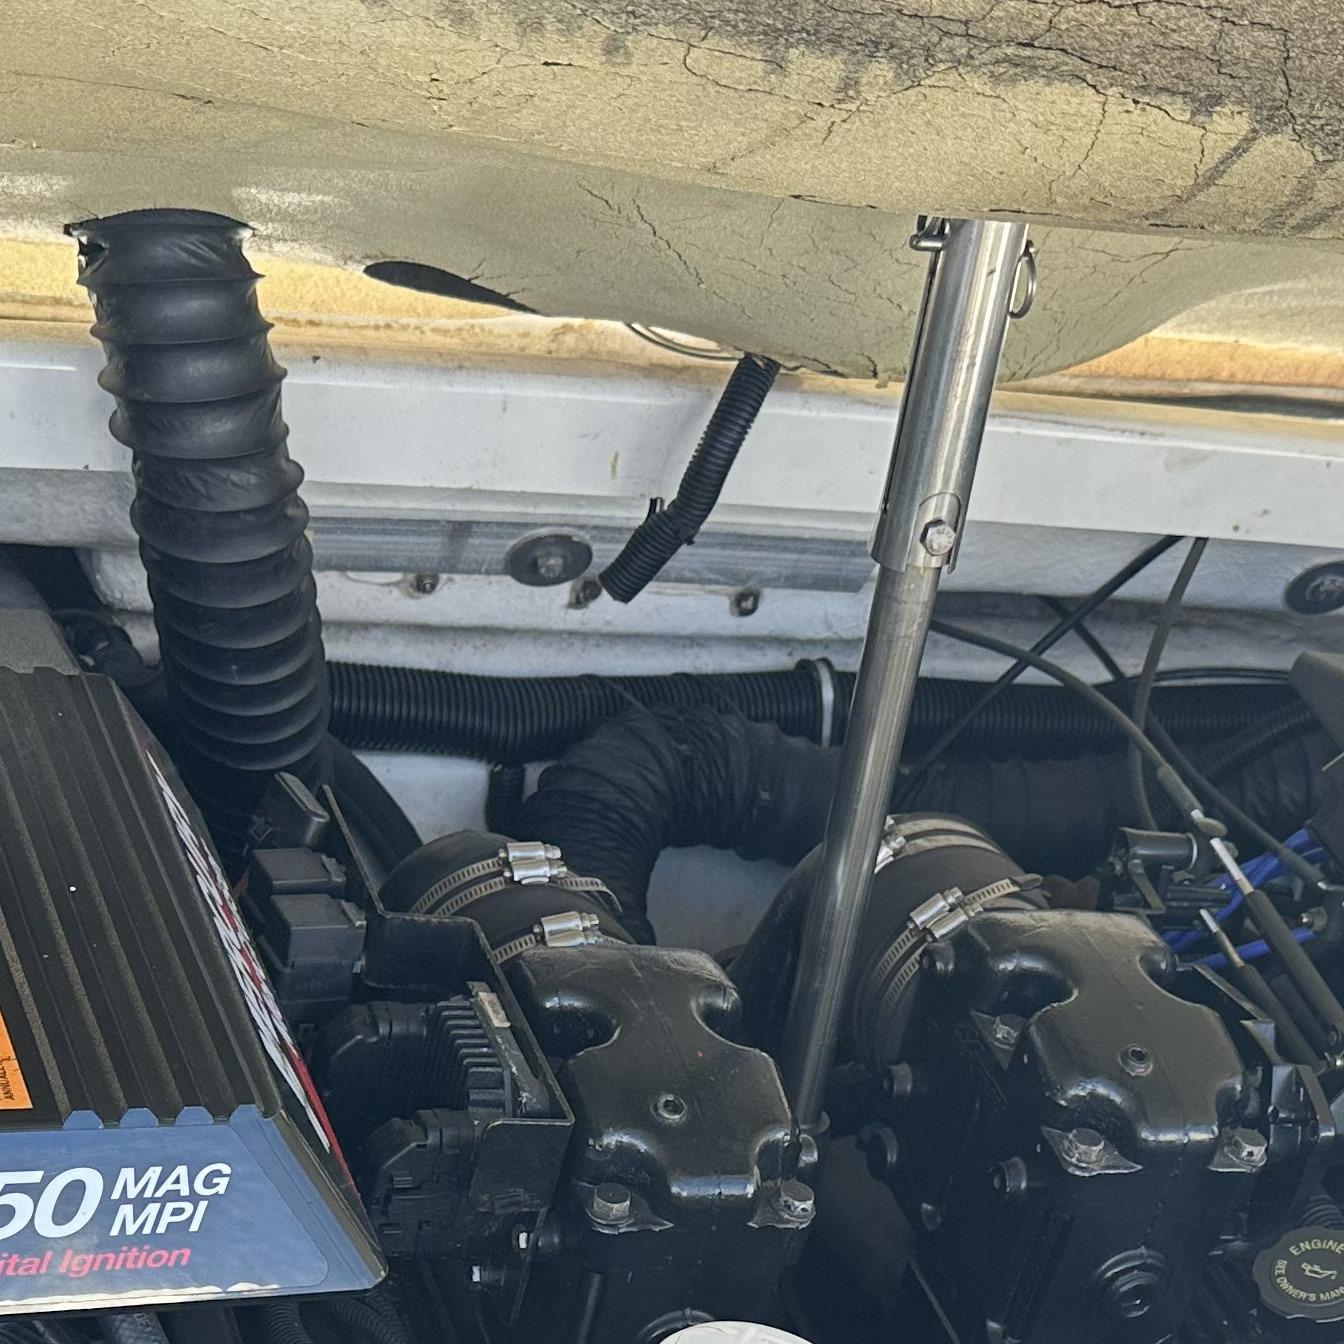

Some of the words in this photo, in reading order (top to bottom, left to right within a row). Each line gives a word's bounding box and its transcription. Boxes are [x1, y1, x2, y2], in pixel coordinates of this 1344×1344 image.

[112, 1163, 232, 1199] MAG
[109, 1200, 208, 1237] MPI
[58, 1244, 191, 1278] Ignition
